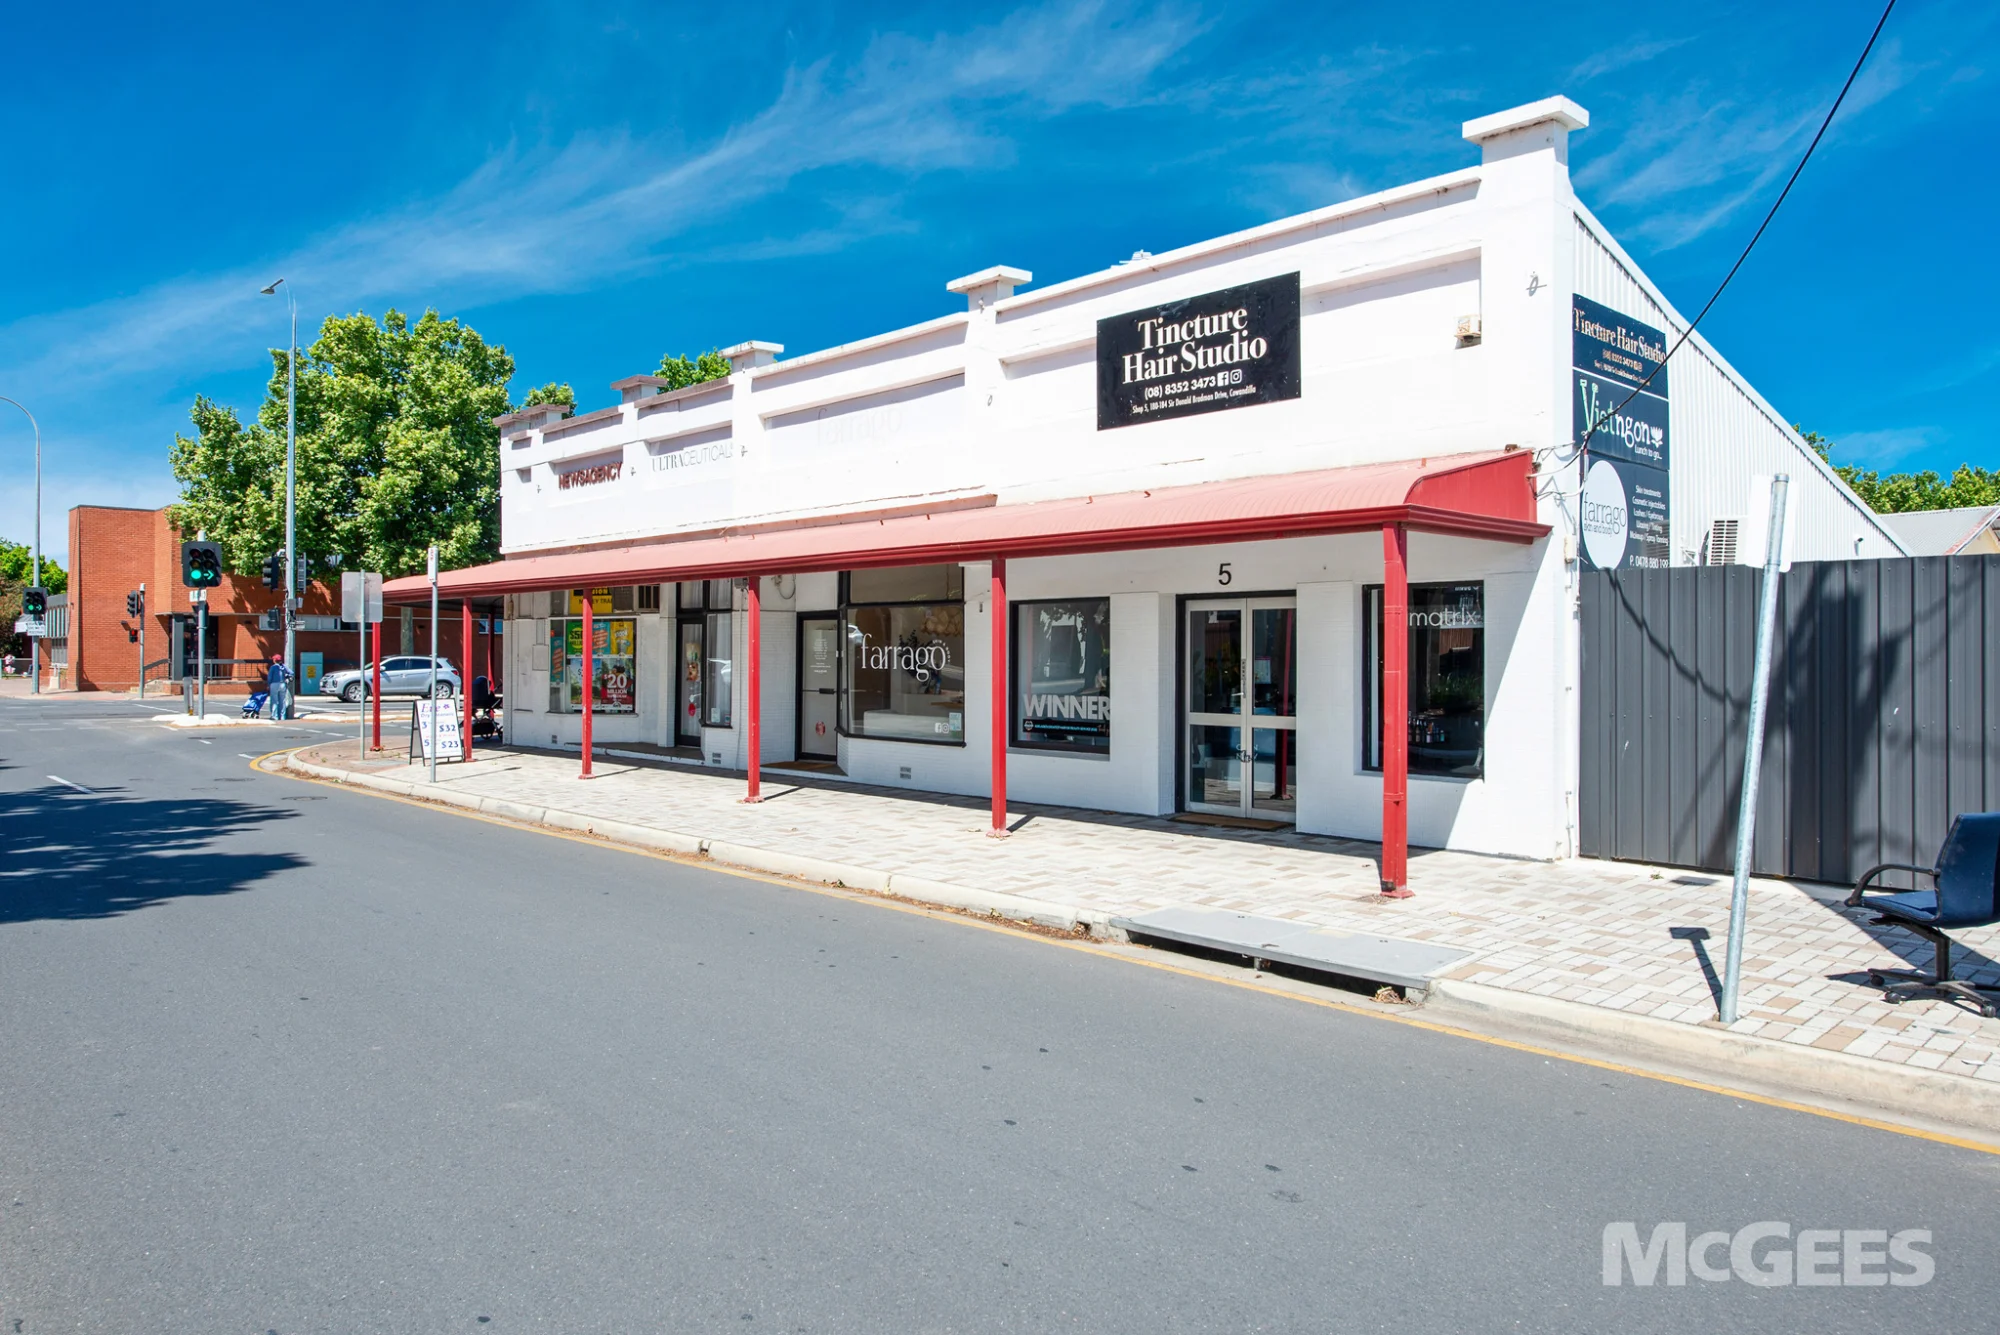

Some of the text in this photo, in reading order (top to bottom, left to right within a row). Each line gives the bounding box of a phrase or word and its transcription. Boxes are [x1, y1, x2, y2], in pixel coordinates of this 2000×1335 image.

[1138, 307, 1248, 350] Tincture
[1573, 307, 1666, 366] Tincture Hair Studio
[1122, 329, 1268, 384] Hair Studio
[1144, 376, 1216, 400] (08) 8352 3473
[1175, 396, 1192, 407] Donald
[558, 461, 623, 490] NEWSAGENCY
[1584, 492, 1626, 535] farrago
[1218, 562, 1232, 586] 5
[1409, 605, 1477, 627] matrix
[861, 633, 946, 682] farrago
[604, 674, 628, 689] $20
[1022, 694, 1110, 720] WINNER
